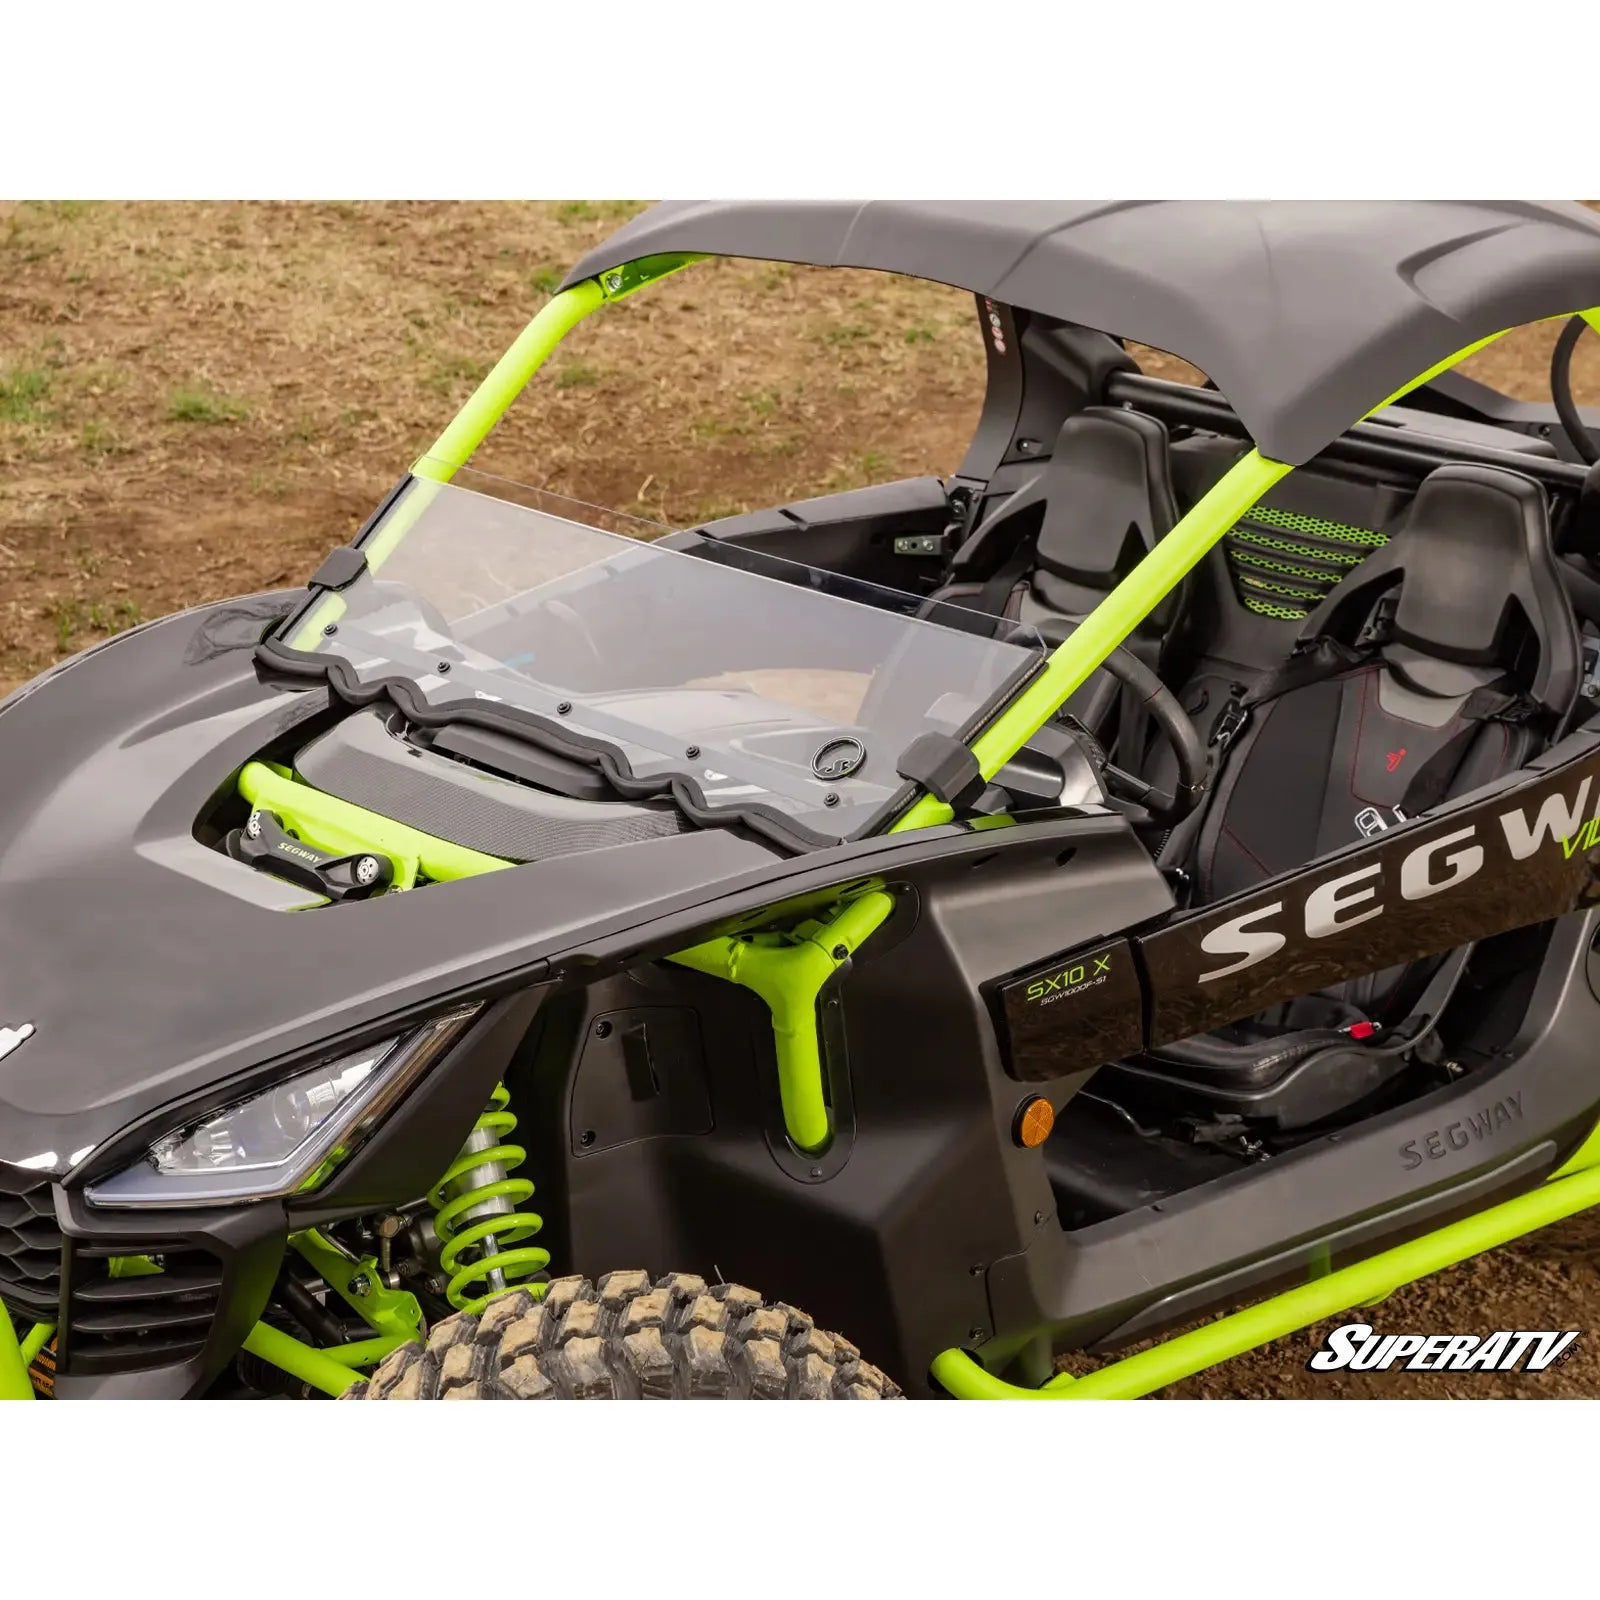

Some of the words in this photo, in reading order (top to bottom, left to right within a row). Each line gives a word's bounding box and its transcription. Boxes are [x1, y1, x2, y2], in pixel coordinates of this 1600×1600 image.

[278, 842, 322, 863] SEGWAY
[1198, 775, 1600, 983] SEGW
[1027, 965, 1085, 1001] SX10
[1093, 954, 1111, 976] X
[1398, 1090, 1523, 1171] SEGWAY
